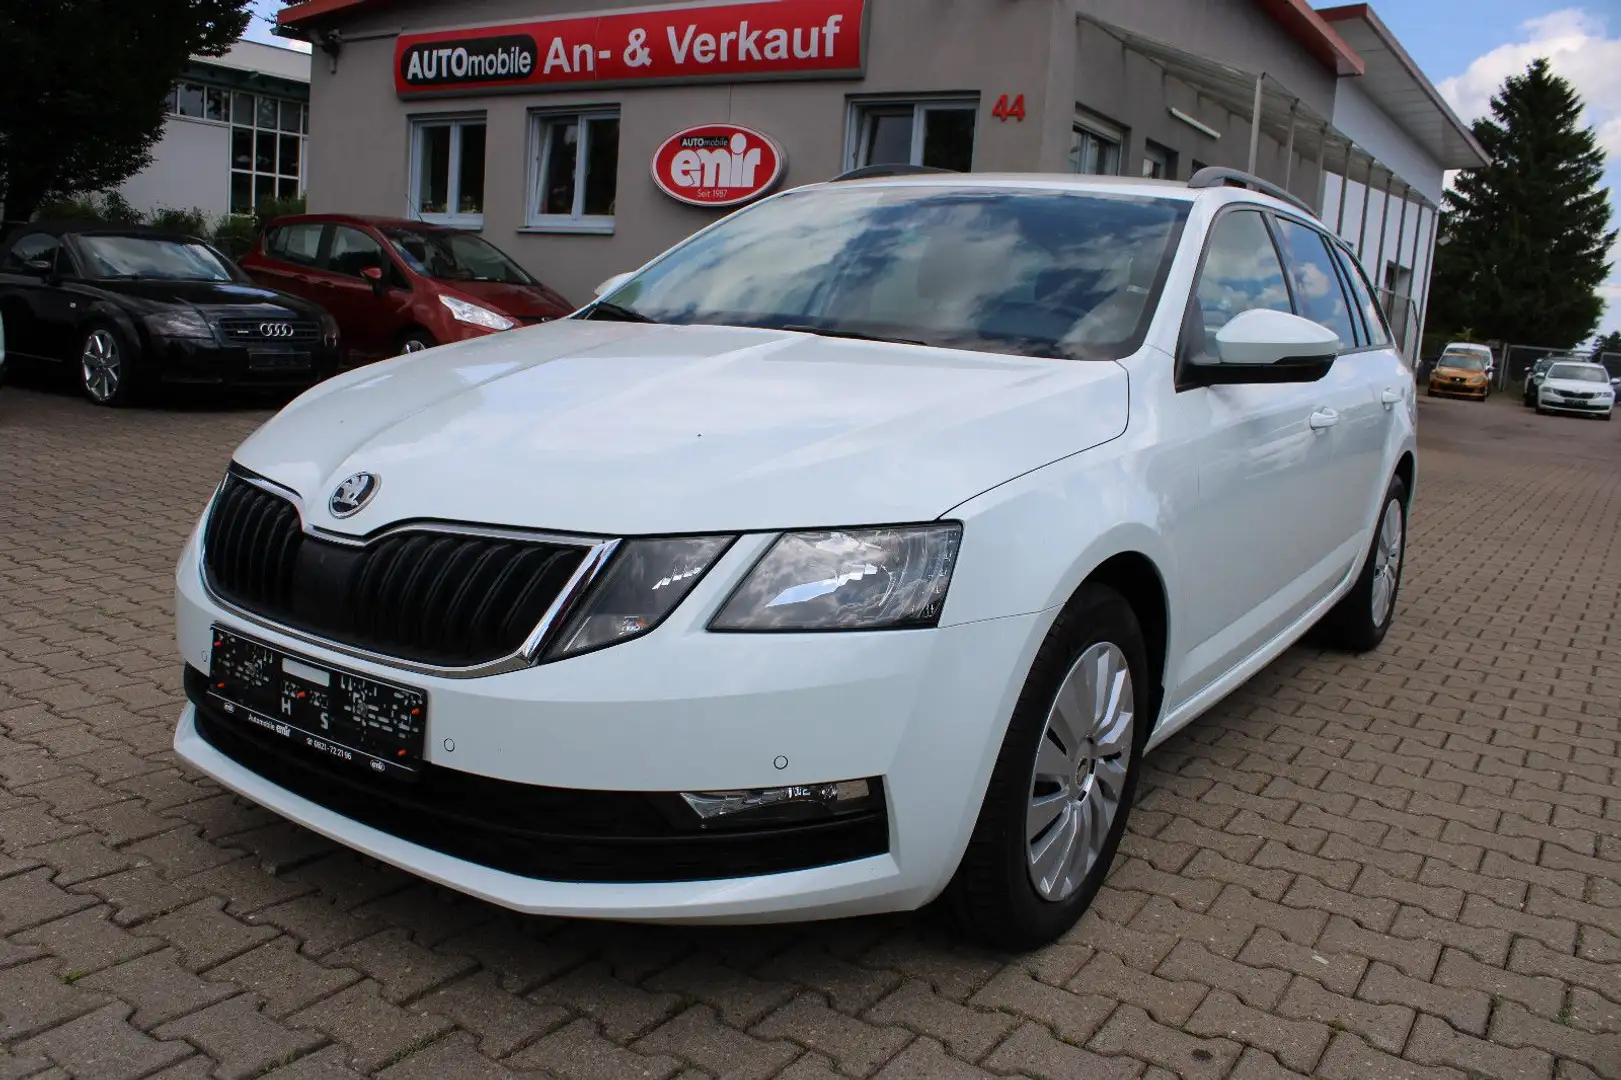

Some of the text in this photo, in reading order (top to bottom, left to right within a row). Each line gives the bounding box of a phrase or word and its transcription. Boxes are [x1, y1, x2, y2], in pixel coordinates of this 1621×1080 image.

[543, 14, 843, 74] An- & Verkauf
[407, 47, 532, 80] AUTOmobile
[992, 93, 1025, 122] 44
[681, 137, 729, 147] AUTOmobile
[670, 132, 761, 188] emir
[696, 188, 728, 198] Seit 1987
[276, 725, 291, 737] emir
